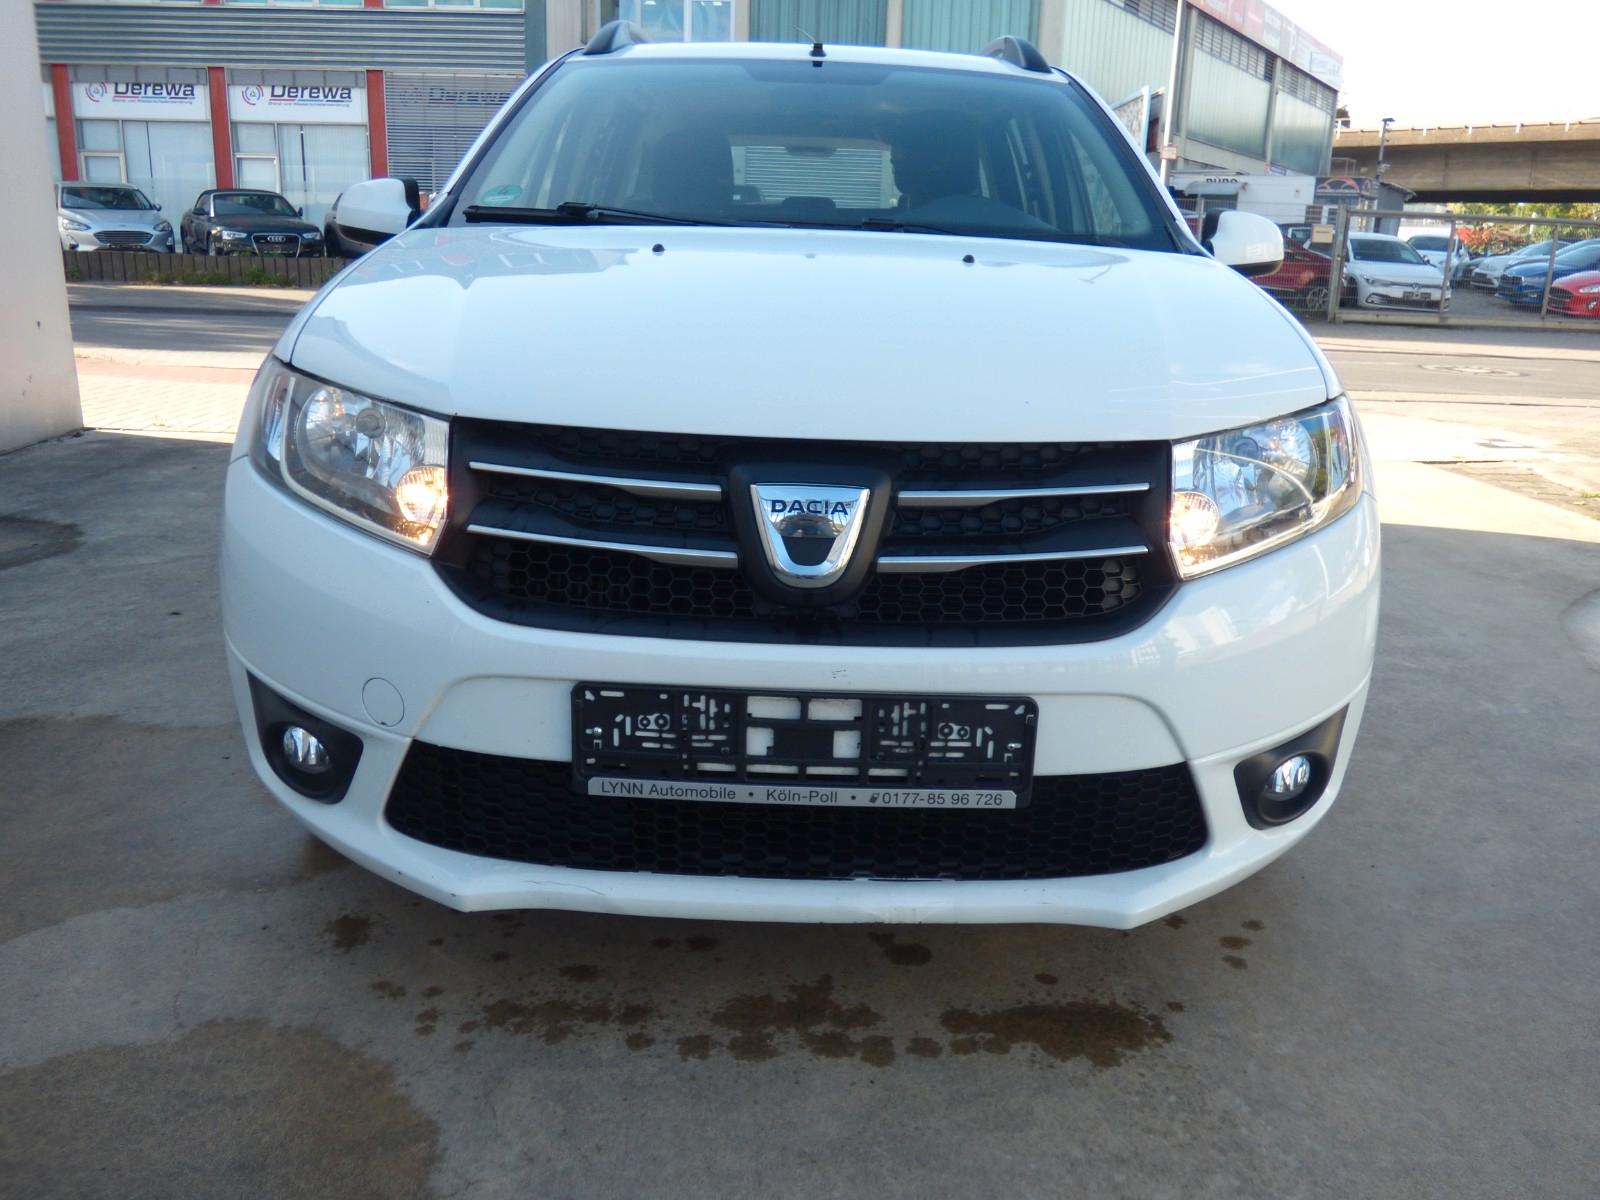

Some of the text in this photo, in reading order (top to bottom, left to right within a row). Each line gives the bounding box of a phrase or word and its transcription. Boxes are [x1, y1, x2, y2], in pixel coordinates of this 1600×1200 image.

[114, 82, 195, 97] Derewa
[270, 85, 352, 99] Derewa
[770, 499, 849, 515] DACIA
[601, 780, 644, 795] LYNN
[648, 783, 737, 800] Automobile
[766, 789, 838, 804] Köln-Poll
[951, 793, 970, 806] 96
[975, 793, 1003, 806] 726
